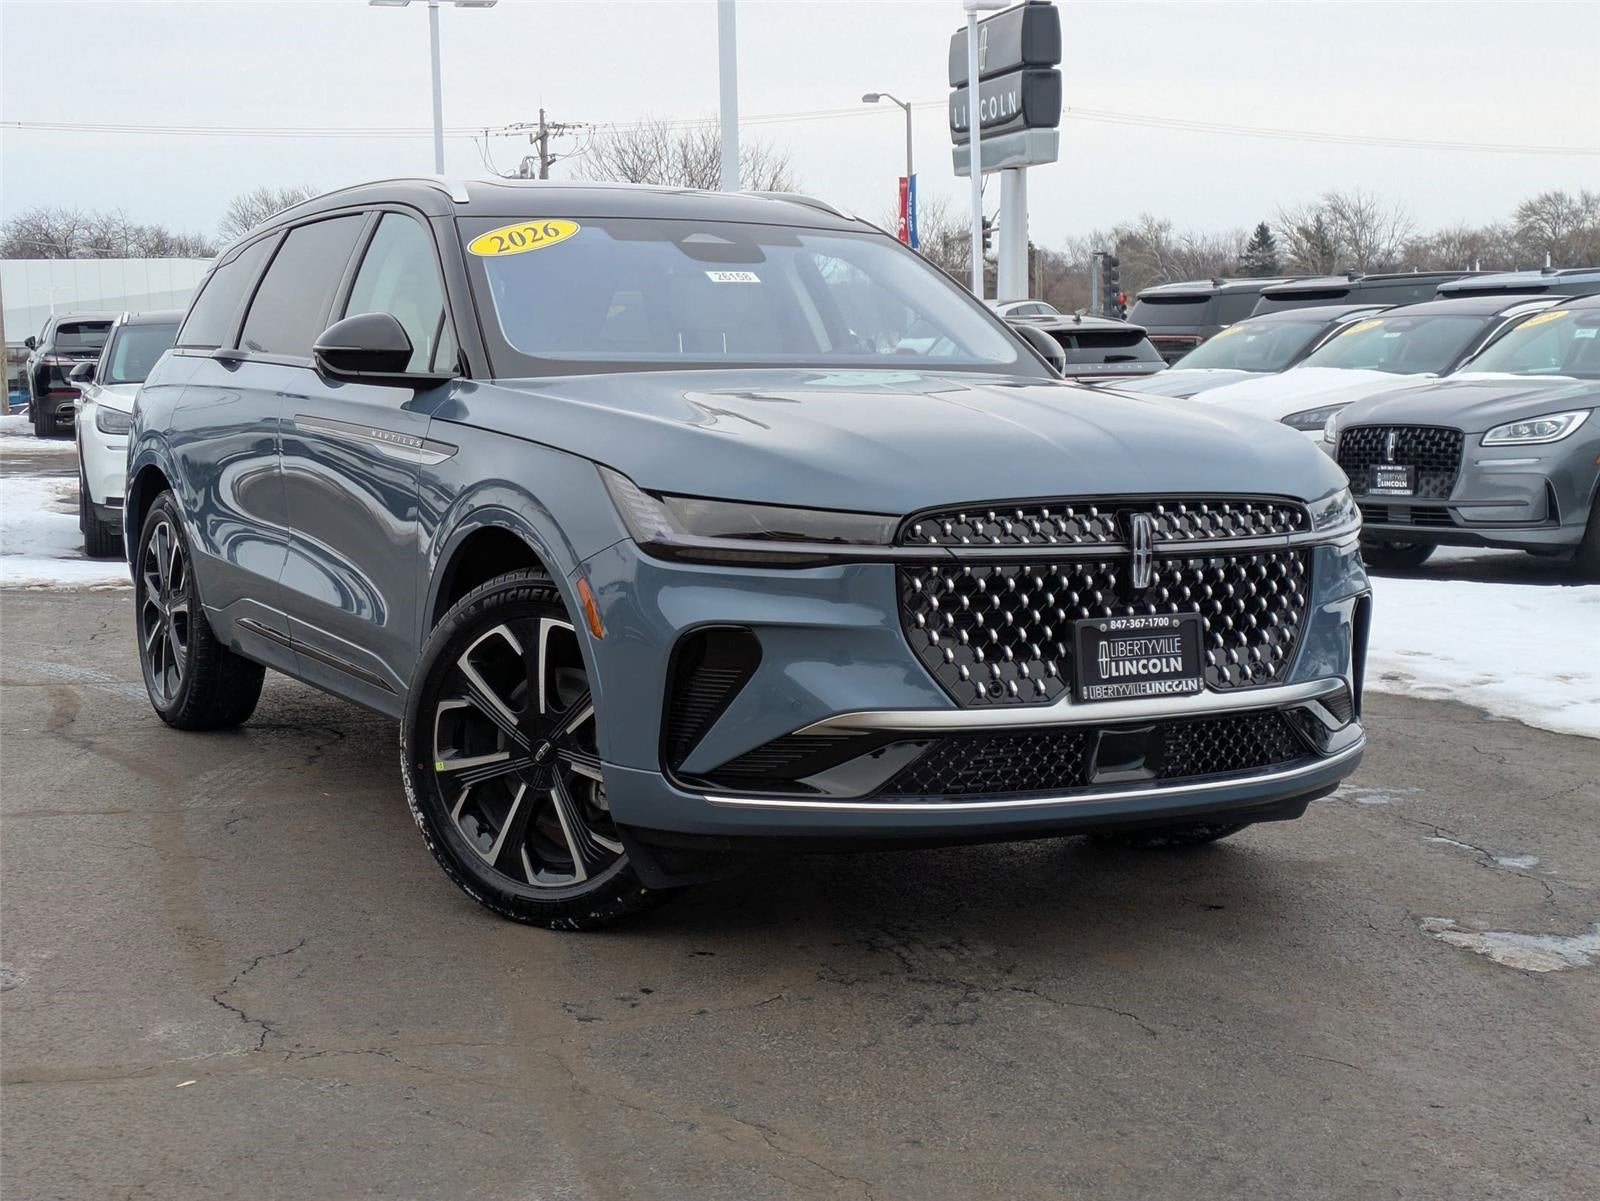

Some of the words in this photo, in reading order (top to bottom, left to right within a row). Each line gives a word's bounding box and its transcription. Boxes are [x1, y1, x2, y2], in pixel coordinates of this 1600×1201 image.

[954, 91, 1017, 129] LICOLN
[489, 222, 560, 253] 2026
[1110, 617, 1169, 629] 847-367-1700
[1110, 637, 1182, 657] LIBERTYVILLE
[1111, 657, 1183, 677] LINCOLN
